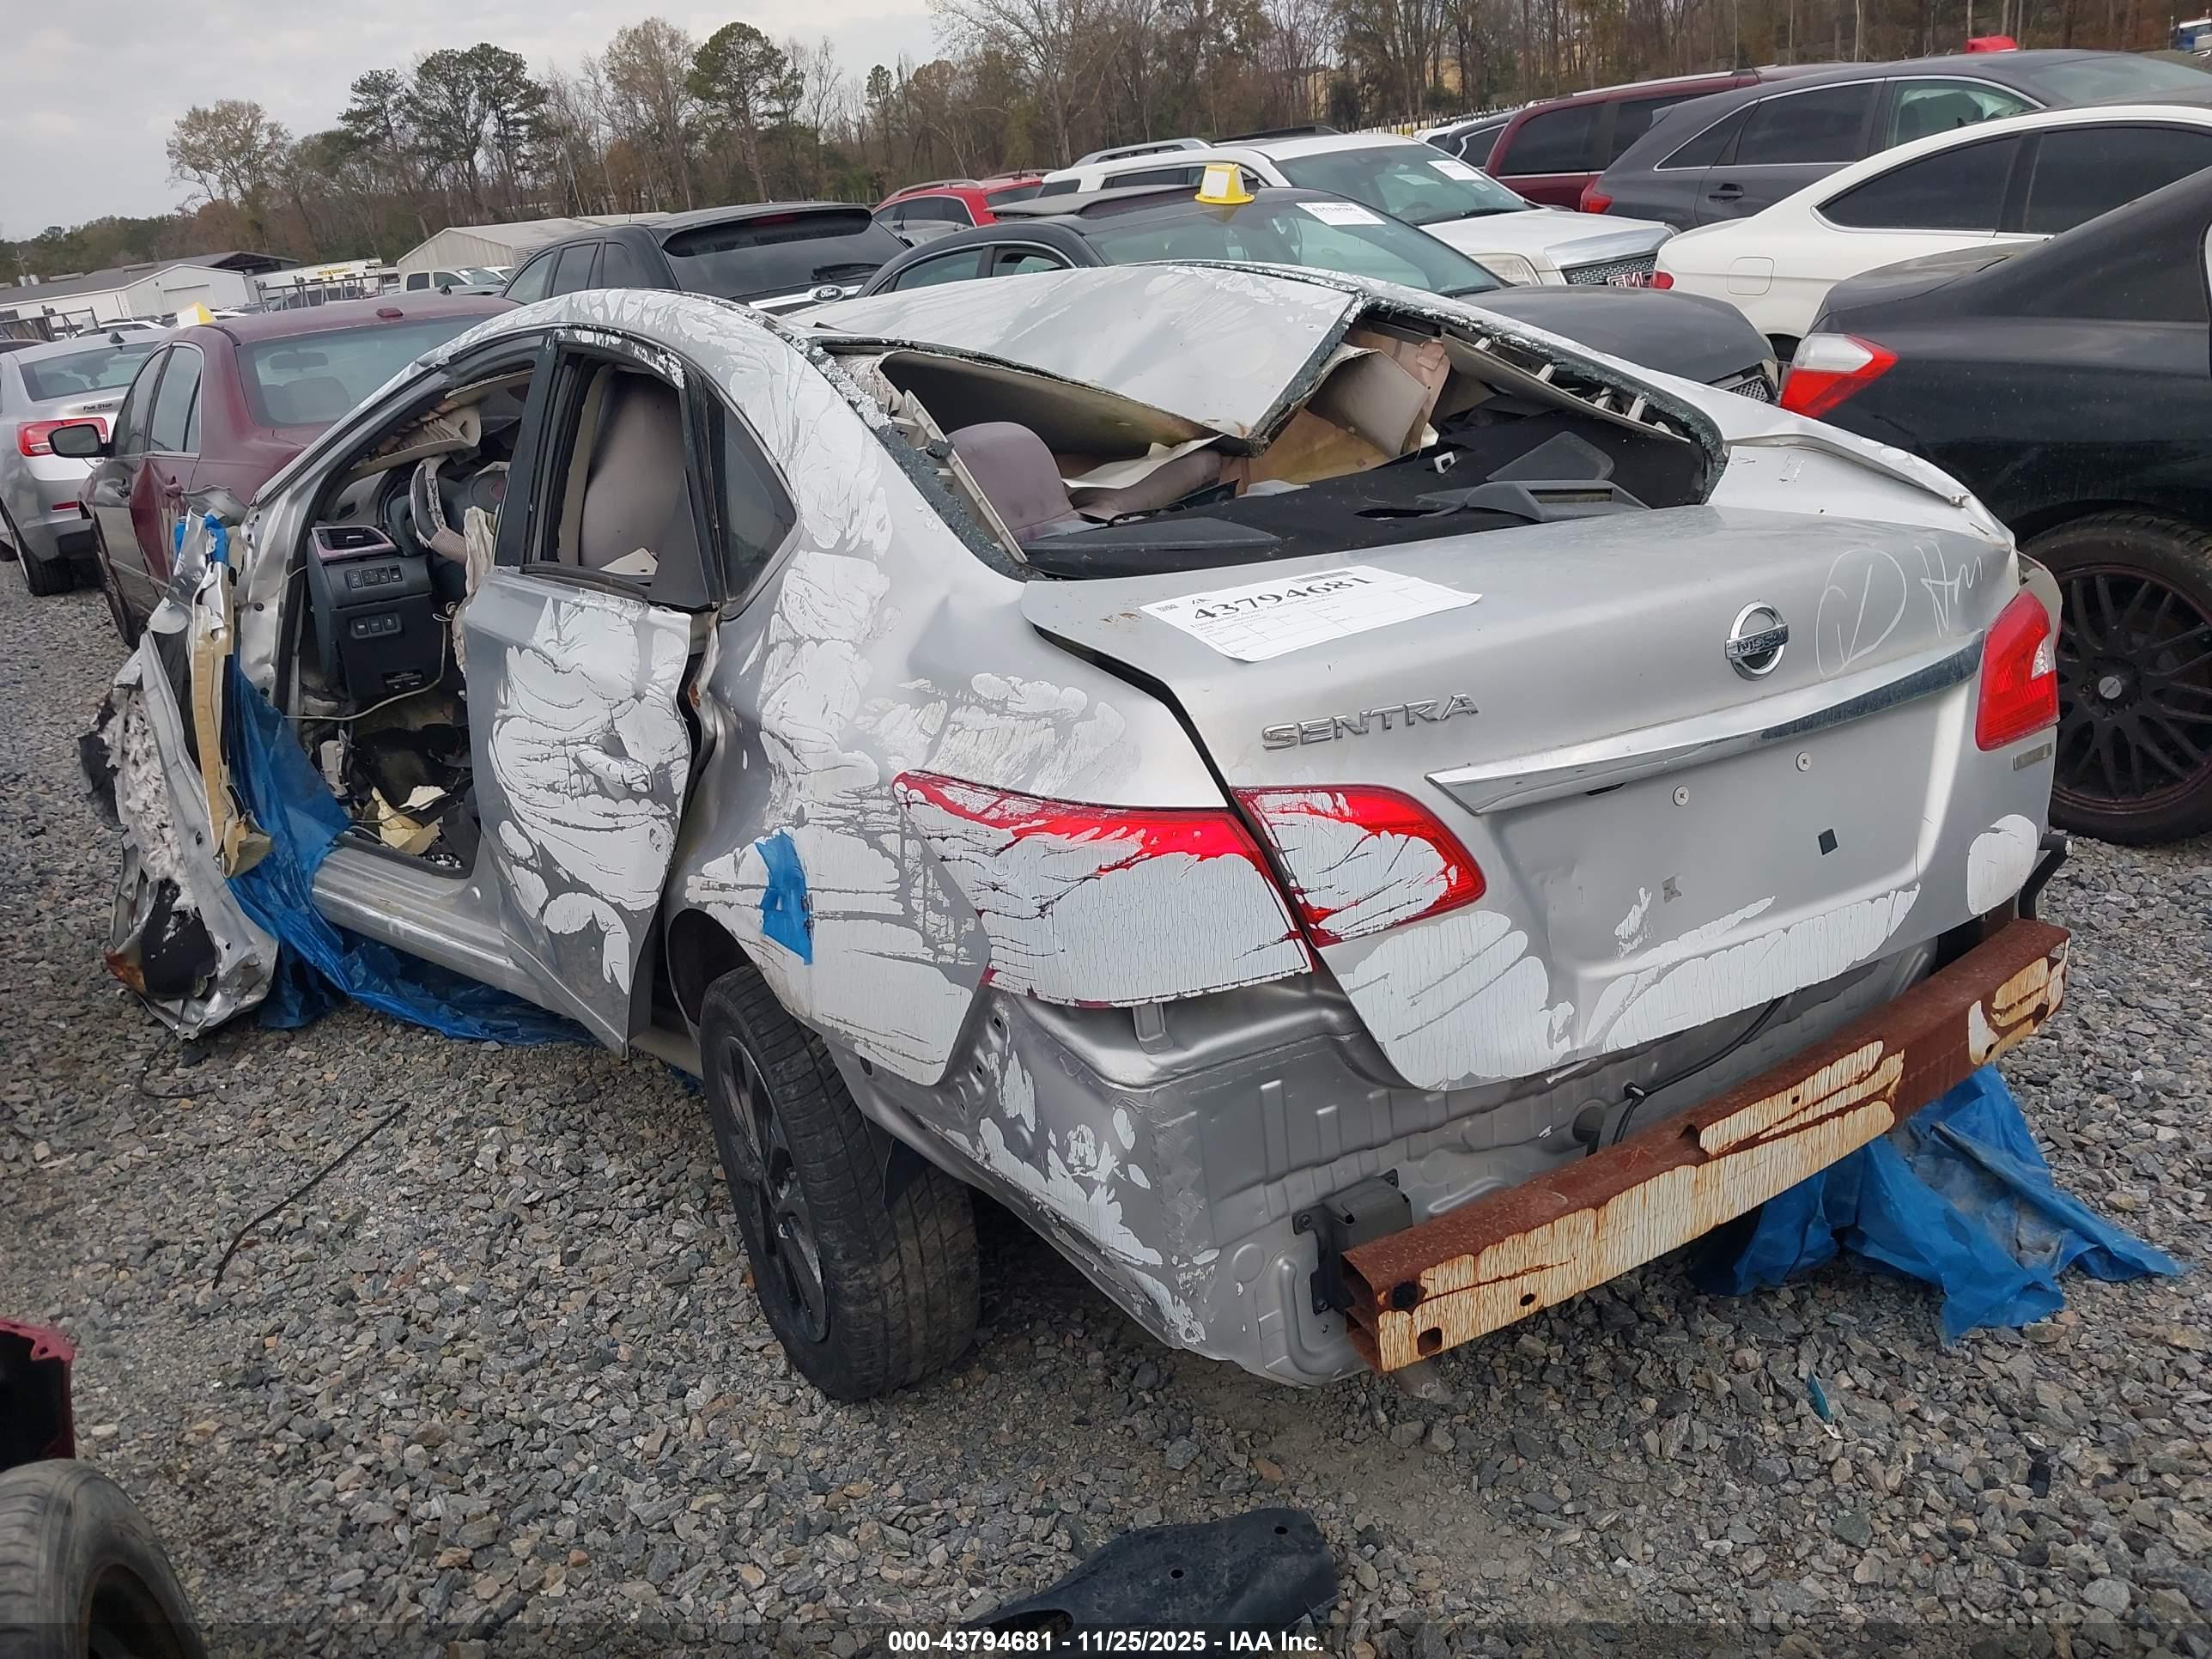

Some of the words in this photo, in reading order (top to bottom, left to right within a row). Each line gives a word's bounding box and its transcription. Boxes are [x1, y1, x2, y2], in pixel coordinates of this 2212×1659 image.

[1194, 577, 1375, 619] 43794681
[1736, 629, 1786, 653] NISSAN
[1261, 693, 1480, 751] SENTRA
